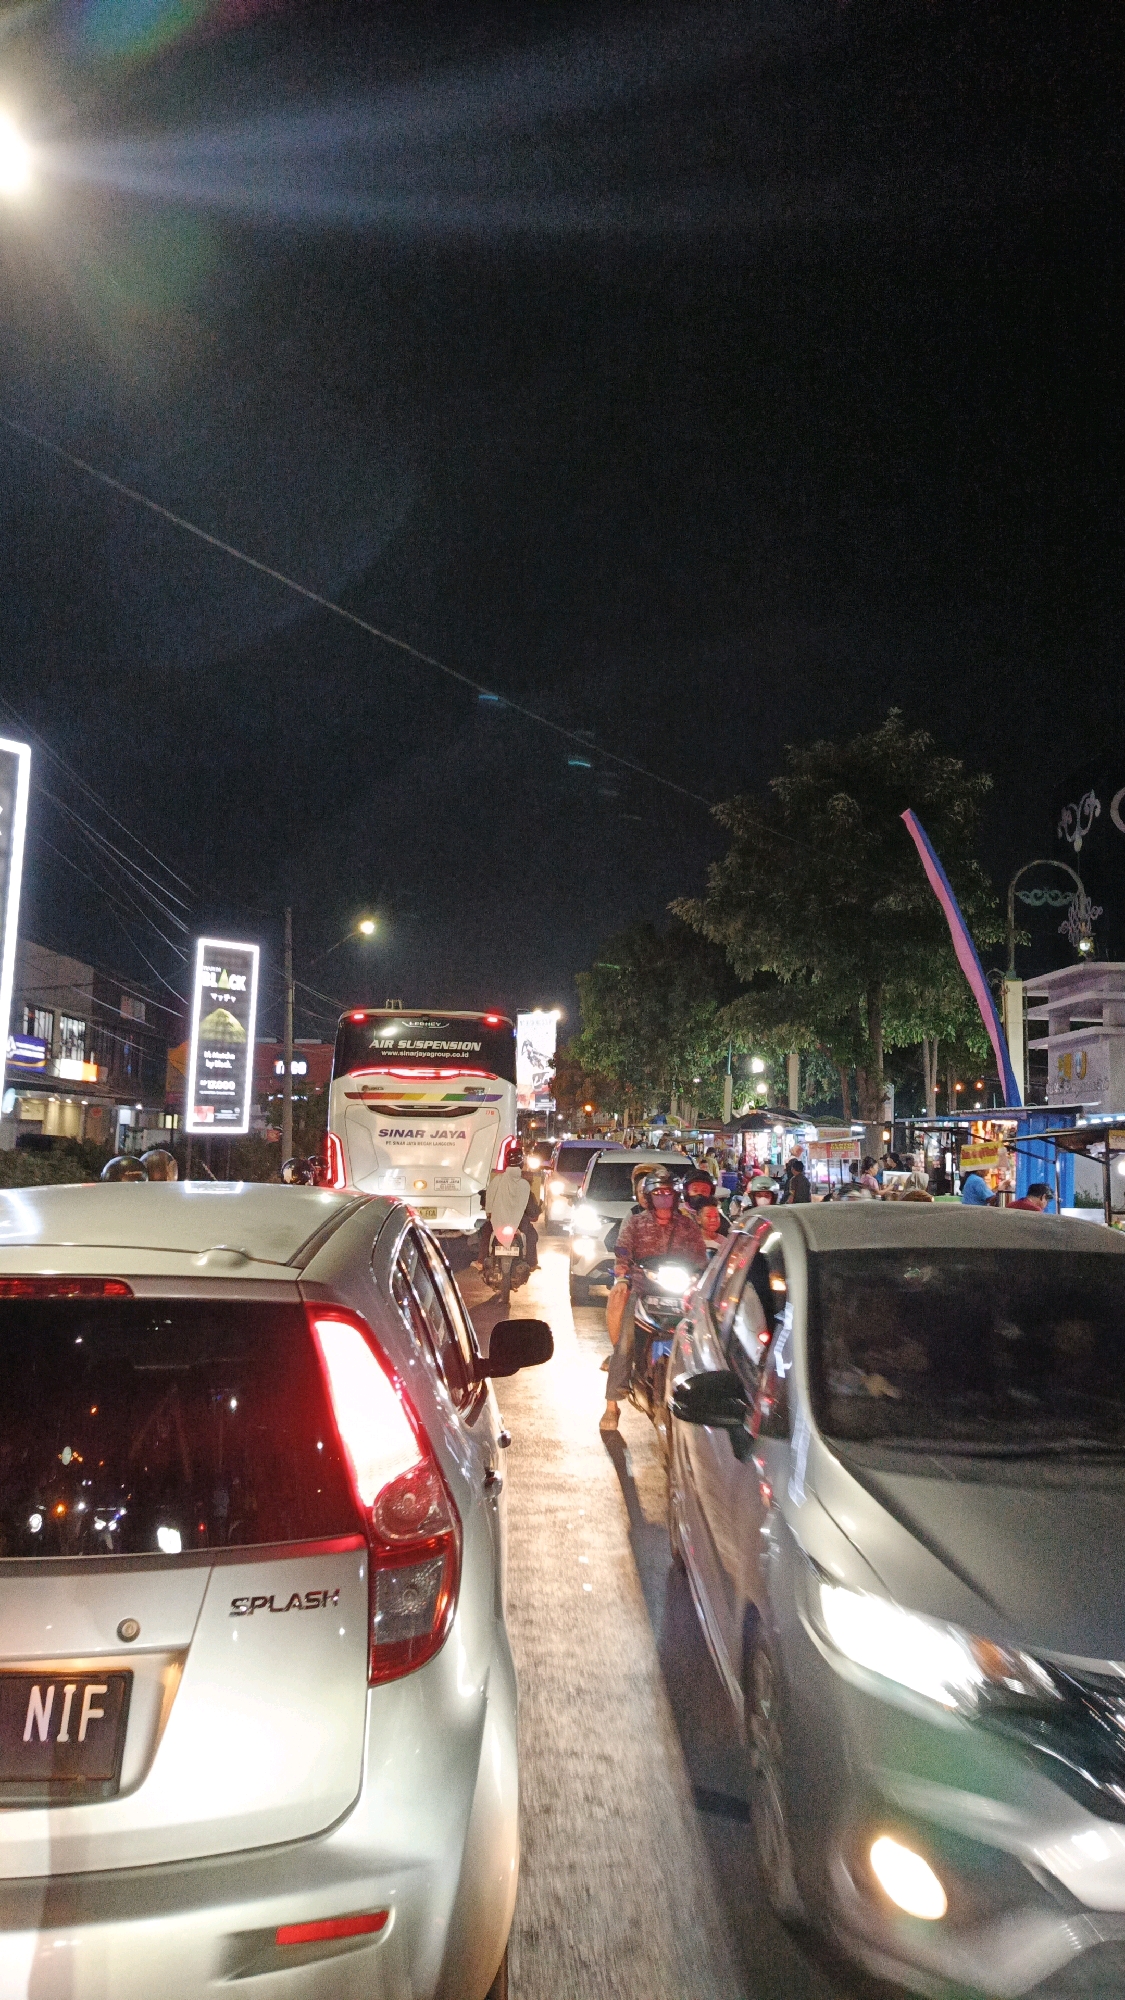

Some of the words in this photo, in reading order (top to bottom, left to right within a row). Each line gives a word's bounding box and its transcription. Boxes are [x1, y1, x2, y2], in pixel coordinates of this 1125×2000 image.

[369, 1039, 395, 1049] AIR
[397, 1040, 481, 1051] SUSPENSION
[381, 1050, 469, 1058] www.sinarjayagroup.co.id
[378, 1129, 426, 1138] SINAR
[430, 1130, 466, 1139] JAYA
[229, 1589, 340, 1617] SPLASH
[23, 1684, 108, 1742] NIF
